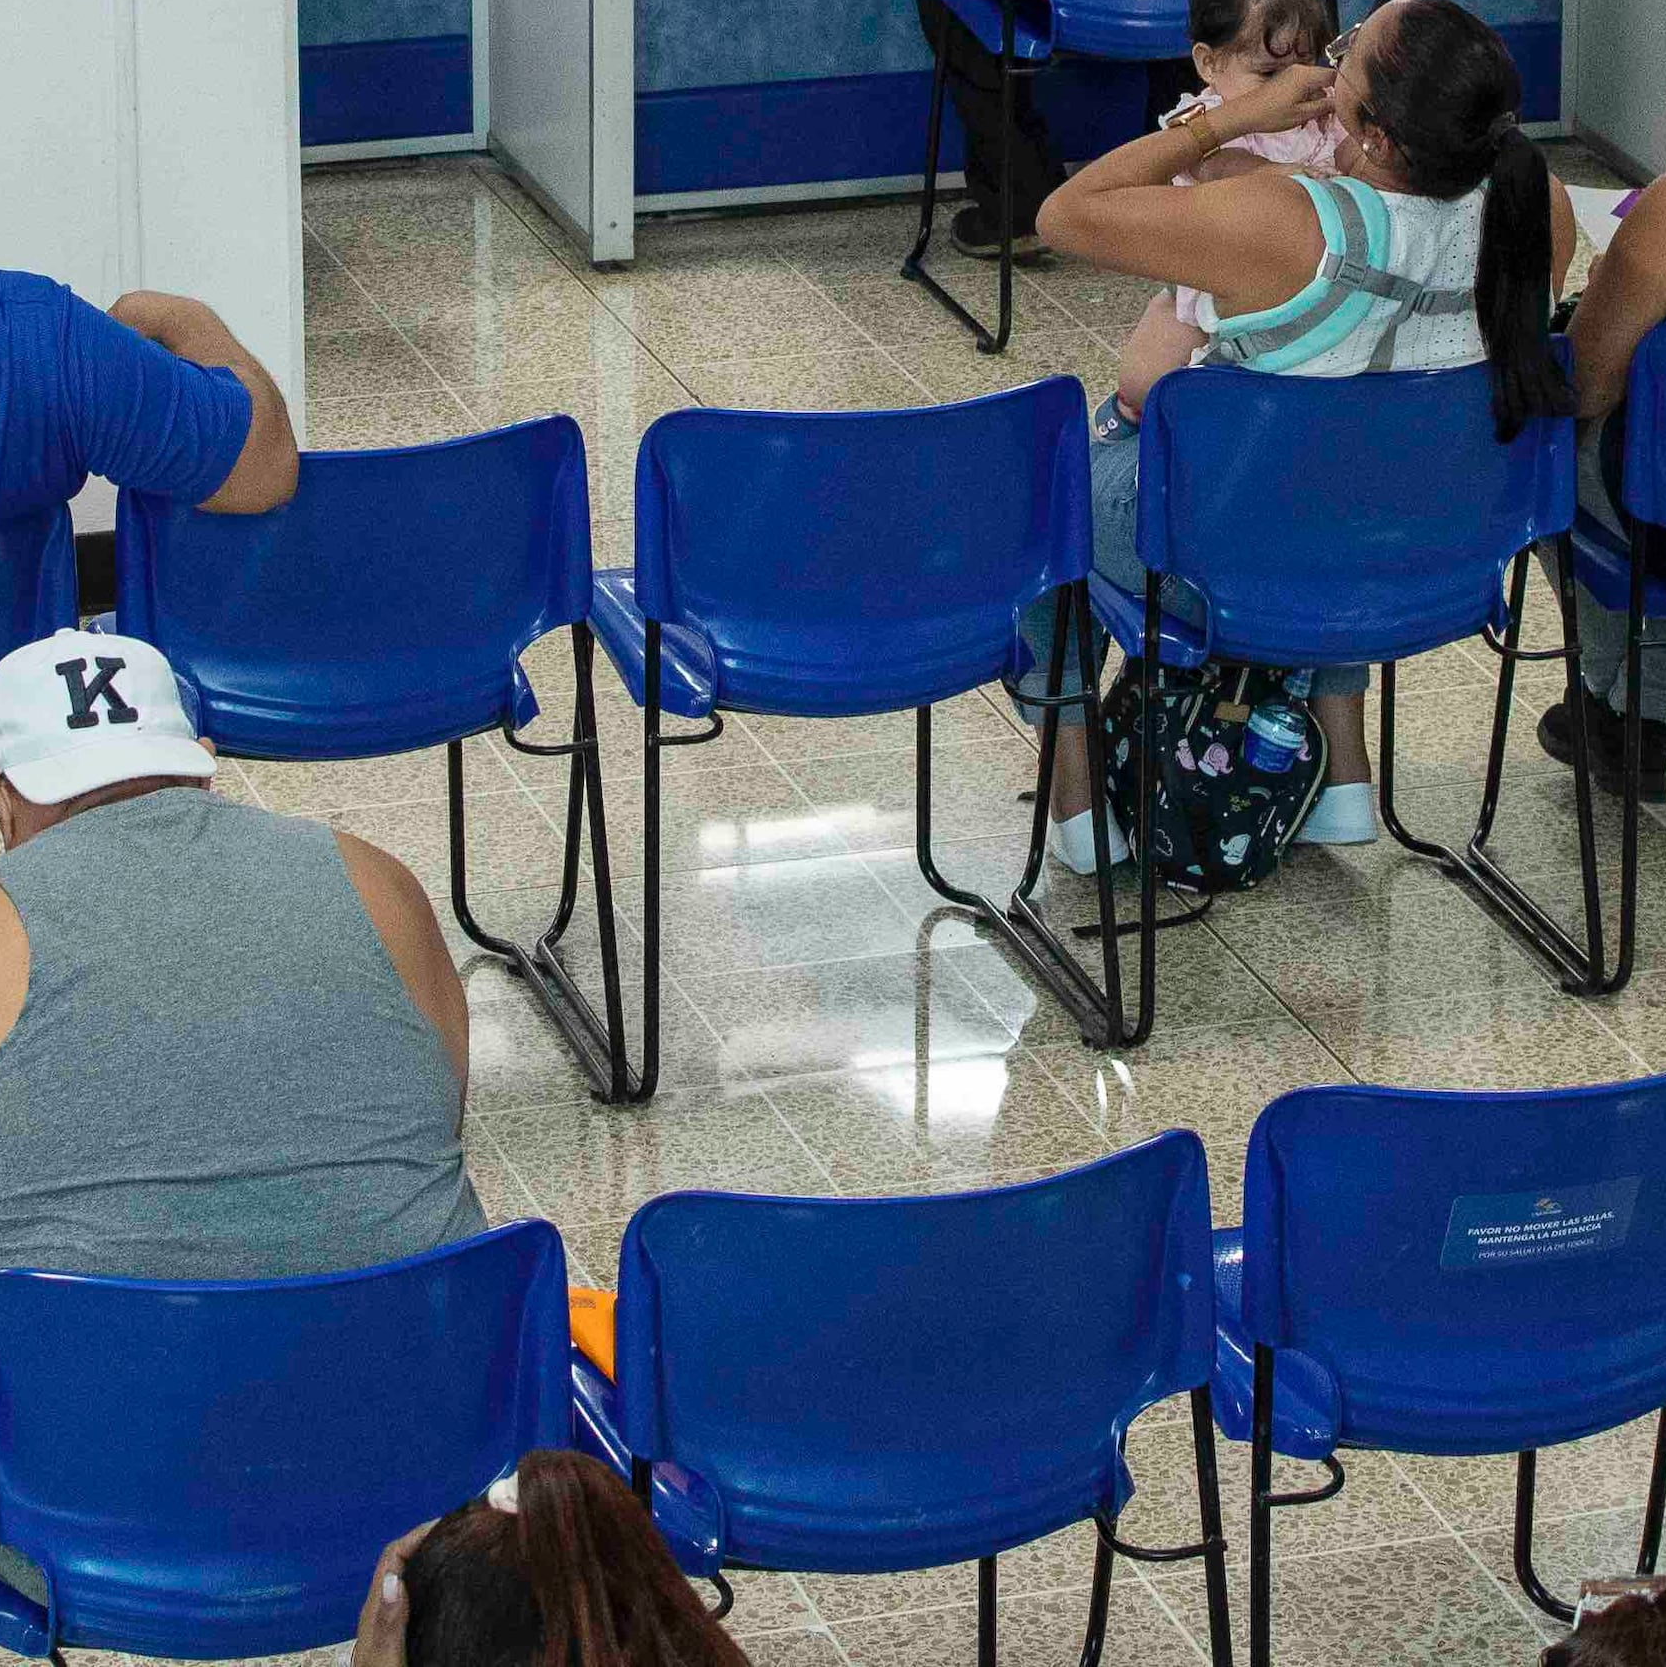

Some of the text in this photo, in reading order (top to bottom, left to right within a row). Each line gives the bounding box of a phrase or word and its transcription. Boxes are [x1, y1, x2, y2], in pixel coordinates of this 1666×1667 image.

[55, 656, 138, 730] K
[1467, 1226, 1502, 1236] FAVOR
[1504, 1225, 1520, 1233] NO
[1523, 1221, 1560, 1232] MOVER
[1562, 1217, 1580, 1226] LAS
[1477, 1223, 1602, 1245] MANTENGA LA DISTANCIA
